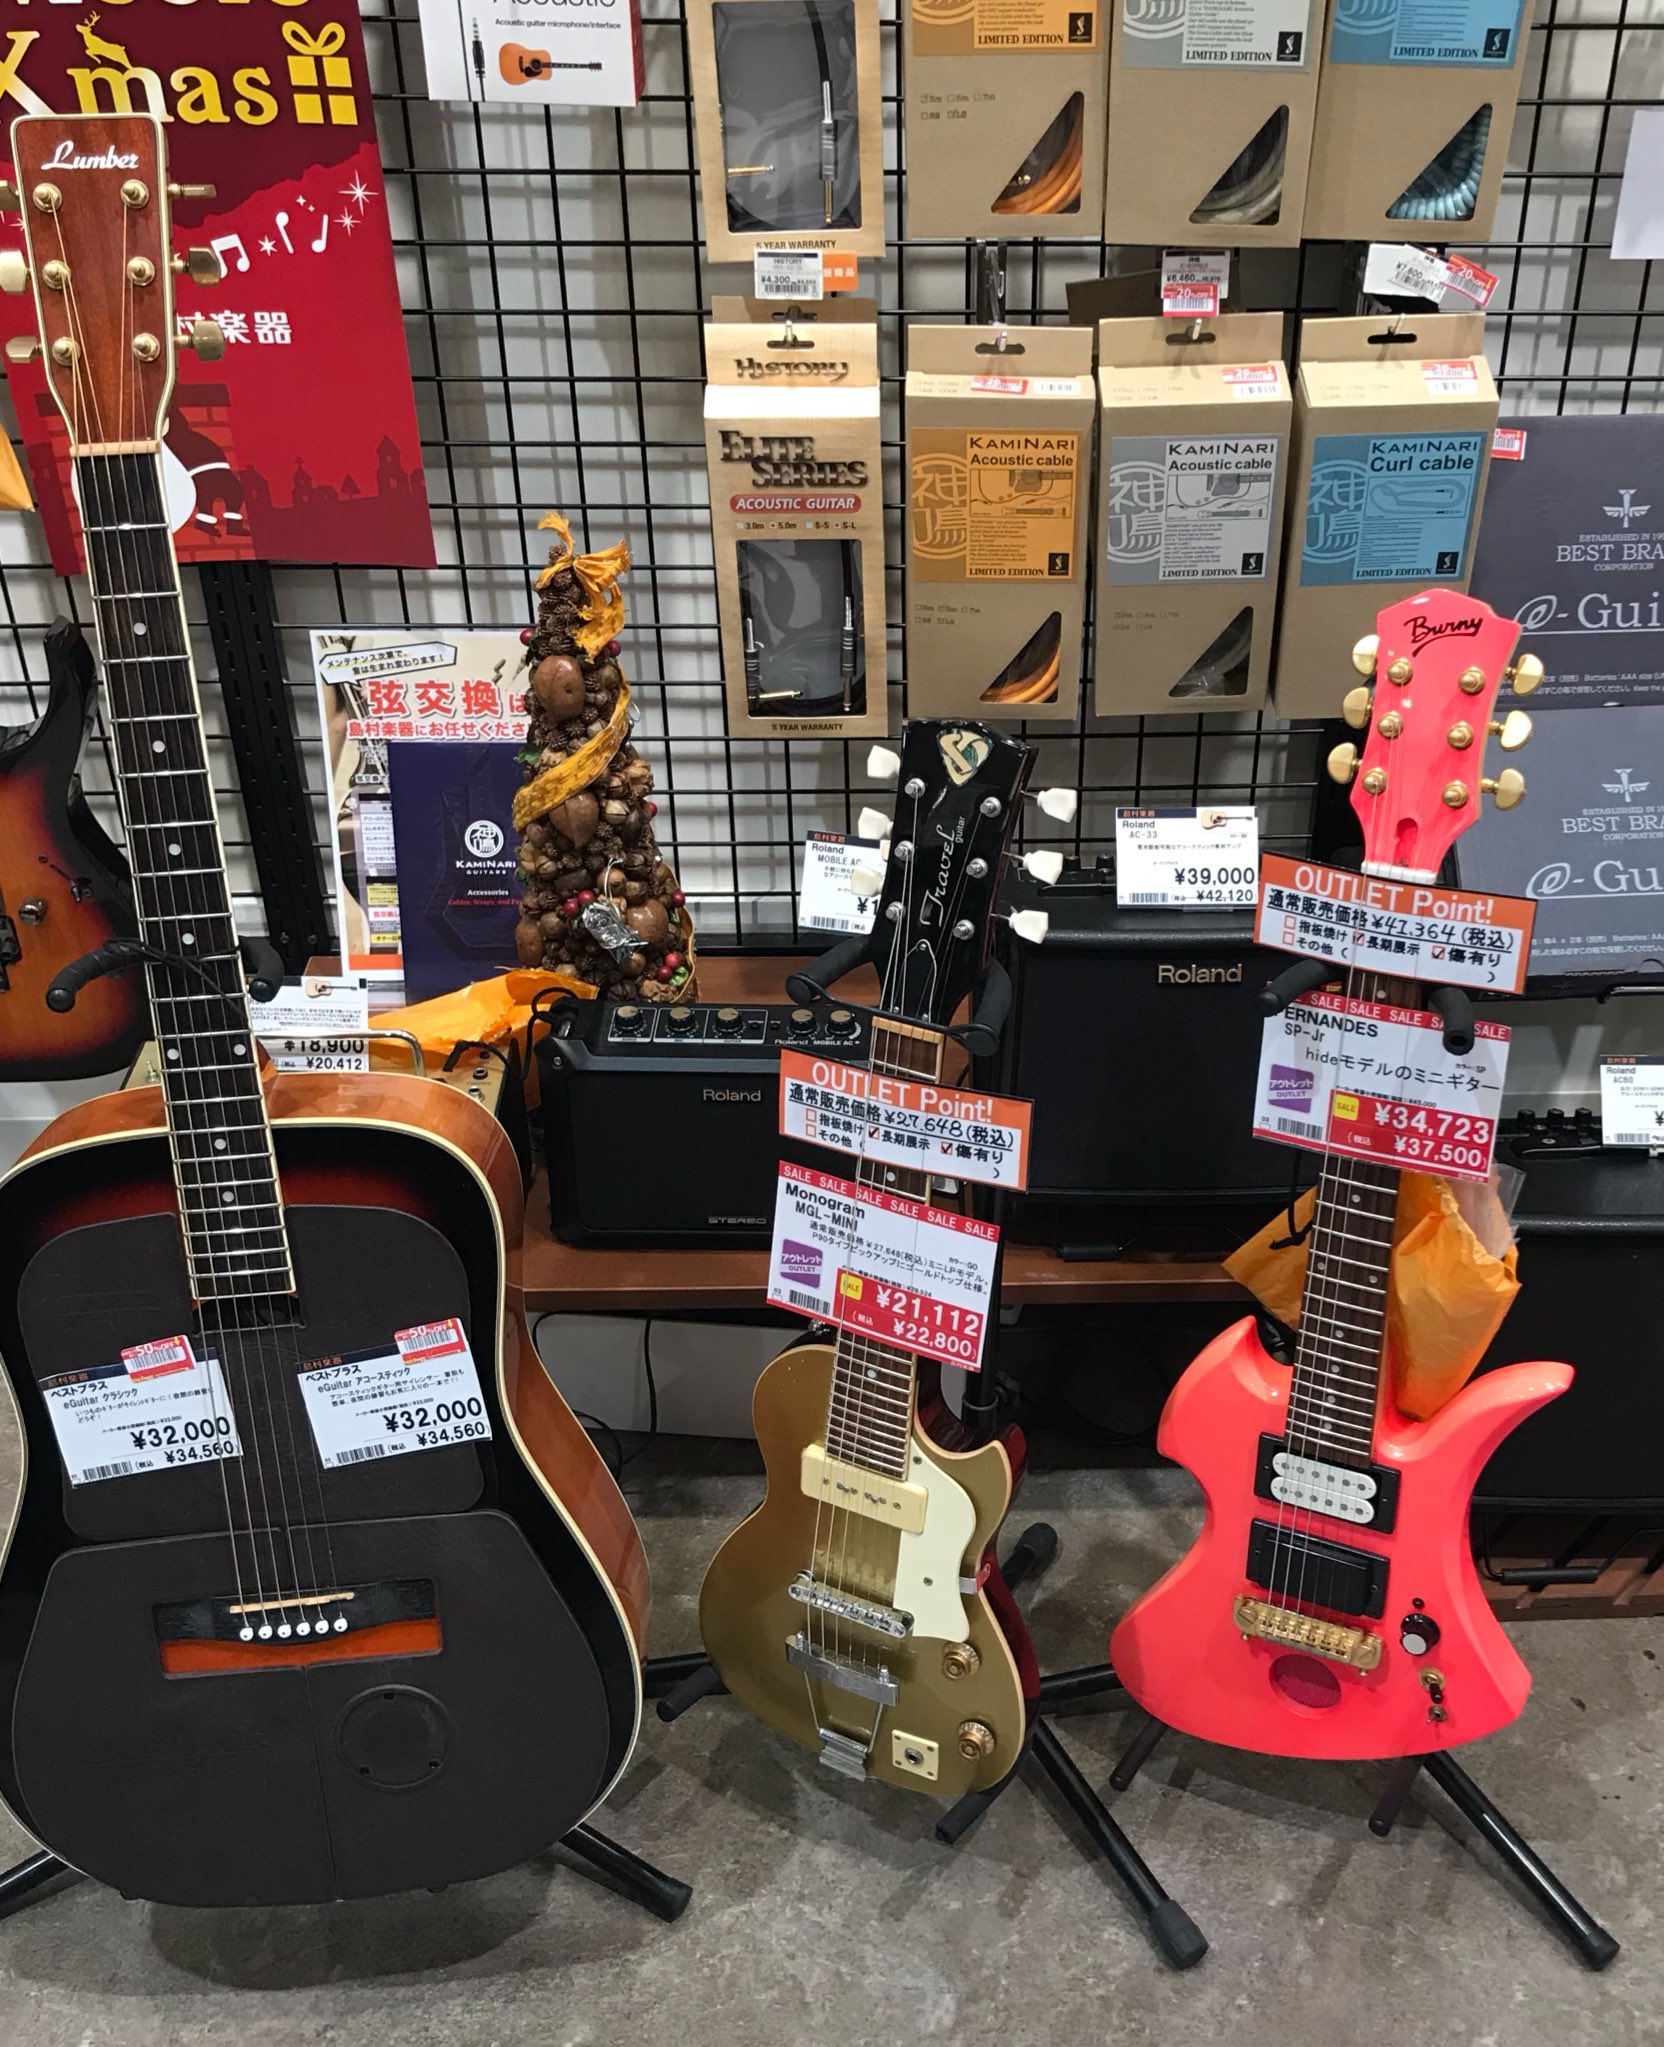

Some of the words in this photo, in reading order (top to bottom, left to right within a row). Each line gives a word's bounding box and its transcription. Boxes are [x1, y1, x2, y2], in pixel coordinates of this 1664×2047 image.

[496, 18, 525, 26] Acoustic
[526, 19, 546, 28] guitar
[978, 34, 1020, 44] LIMITED
[1022, 34, 1064, 44] EDITION
[1186, 51, 1228, 61] LIMITED
[1230, 51, 1272, 62] EDITION
[1393, 46, 1435, 57] LIMITED
[1437, 48, 1479, 58] EDITION
[41, 140, 140, 171] Lumber
[764, 242, 786, 250] YEAR
[788, 240, 836, 249] WARRANTY
[760, 275, 790, 284] ¥4,300
[718, 429, 815, 463] ELITE
[970, 437, 1074, 450] KAMINARI
[1168, 442, 1274, 456] KAMINARI
[1372, 440, 1478, 454] KAMINARI
[970, 454, 1034, 466] Acoustic
[1036, 454, 1074, 466] cable
[1168, 459, 1232, 471] Acoustic
[1235, 458, 1272, 470] cable
[1370, 456, 1414, 472] Curl
[1419, 454, 1474, 470] cable
[751, 455, 869, 489] SERIES
[736, 497, 801, 510] ACOUSTIC
[806, 497, 856, 510] GUITAR
[746, 522, 764, 530] 3.0m
[778, 522, 797, 530] 5.0m
[814, 522, 830, 530] S-S
[842, 522, 856, 530] S-L
[1579, 533, 1640, 542] ESTABLISHED
[1641, 532, 1650, 540] IN
[1556, 543, 1615, 562] BEST
[969, 568, 1006, 576] LIMITED
[1008, 568, 1044, 576] EDITION
[1162, 569, 1198, 578] LIMITED
[1201, 568, 1238, 576] EDITION
[1356, 568, 1393, 578] LIMITED
[1395, 568, 1432, 576] EDITION
[1594, 562, 1654, 572] CORPORATION
[1403, 616, 1484, 658] Burny
[368, 680, 526, 716] 弦交換は
[778, 724, 799, 732] YEAR
[955, 816, 966, 844] guitar
[1122, 820, 1155, 828] Roland
[1561, 816, 1620, 834] BEST
[811, 842, 845, 854] Roland
[456, 860, 516, 868] KAMINARI
[817, 854, 848, 865] MOBILE
[1174, 867, 1256, 886] ¥39,000
[1196, 889, 1254, 902] ¥42,120
[1294, 865, 1404, 910] OUTLET
[1412, 889, 1495, 926] Point!
[1298, 920, 1348, 942] 指板焼け
[1366, 935, 1420, 956] 長期展示
[1296, 938, 1334, 957] その他
[1158, 963, 1242, 984] Roland
[1274, 1006, 1378, 1038] ERNANDES
[1310, 992, 1342, 1012] SALE
[1350, 1000, 1381, 1020] SALE
[1389, 1008, 1422, 1026] SALE
[1474, 1022, 1507, 1040] SALE
[1284, 1021, 1326, 1043] SP-Jr
[1305, 1046, 1500, 1091] hideモデルのミニギター
[1606, 1066, 1636, 1074] Roland
[1270, 1077, 1314, 1090] アウトレット
[703, 1088, 762, 1102] Roland
[812, 1061, 911, 1107] OUTLET
[920, 1086, 994, 1124] Point!
[1276, 1090, 1307, 1099] OUTLET
[1336, 1101, 1357, 1113] SALE
[1374, 1102, 1490, 1144] ¥34,723
[818, 1112, 864, 1136] 指板焼け
[881, 1129, 931, 1152] 長期展示
[818, 1129, 852, 1149] その他
[784, 1166, 812, 1184] SALE
[819, 1176, 848, 1195] SALE
[856, 1187, 883, 1206] SALE
[890, 1199, 919, 1218] SALE
[927, 1210, 956, 1229] SALE
[964, 1222, 996, 1241] SALE
[786, 1182, 866, 1220] Monogram
[708, 1216, 767, 1224] STEREO
[794, 1201, 858, 1232] MGL-MINI
[781, 1252, 822, 1265] アウトレット
[788, 1265, 816, 1273] OUTLET
[876, 1285, 979, 1337] ¥21,112
[318, 1380, 352, 1393] eGuitar
[356, 1368, 411, 1386] アコースティック
[64, 1396, 99, 1410] eGuitar
[102, 1388, 139, 1401] クラシック
[383, 1398, 483, 1433] ¥32,000
[130, 1416, 231, 1450] ¥32,000
